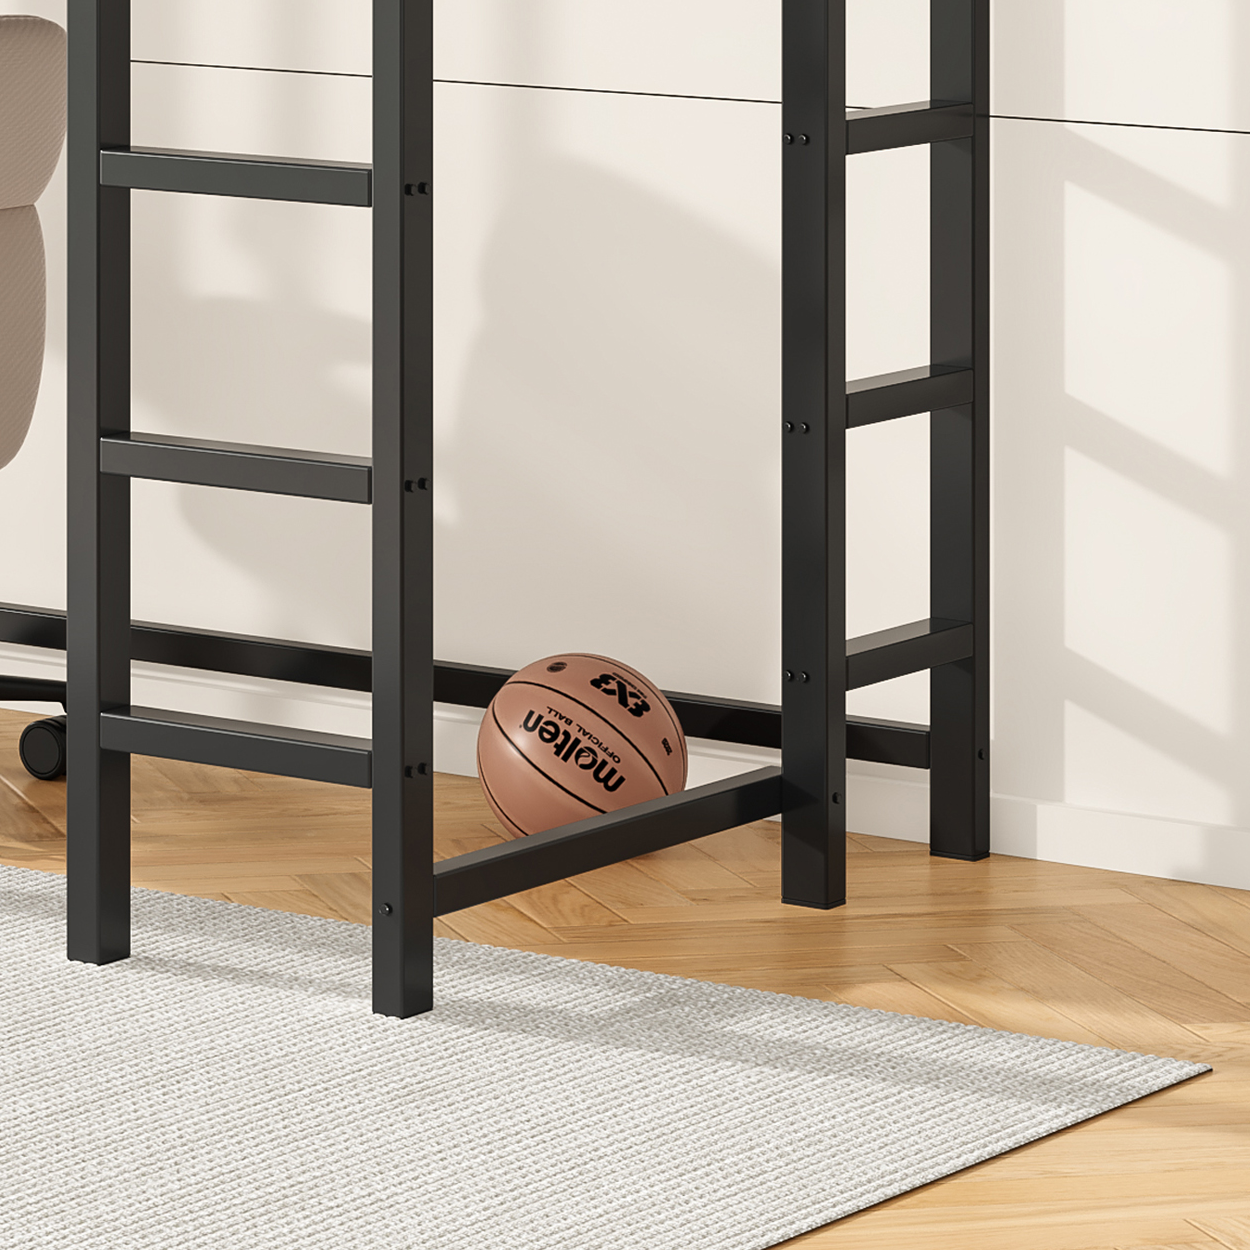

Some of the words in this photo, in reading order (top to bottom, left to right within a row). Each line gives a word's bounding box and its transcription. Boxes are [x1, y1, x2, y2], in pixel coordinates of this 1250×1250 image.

[546, 705, 573, 726] BALL
[521, 708, 627, 793] molten
[575, 722, 622, 765] OFFICIAL
